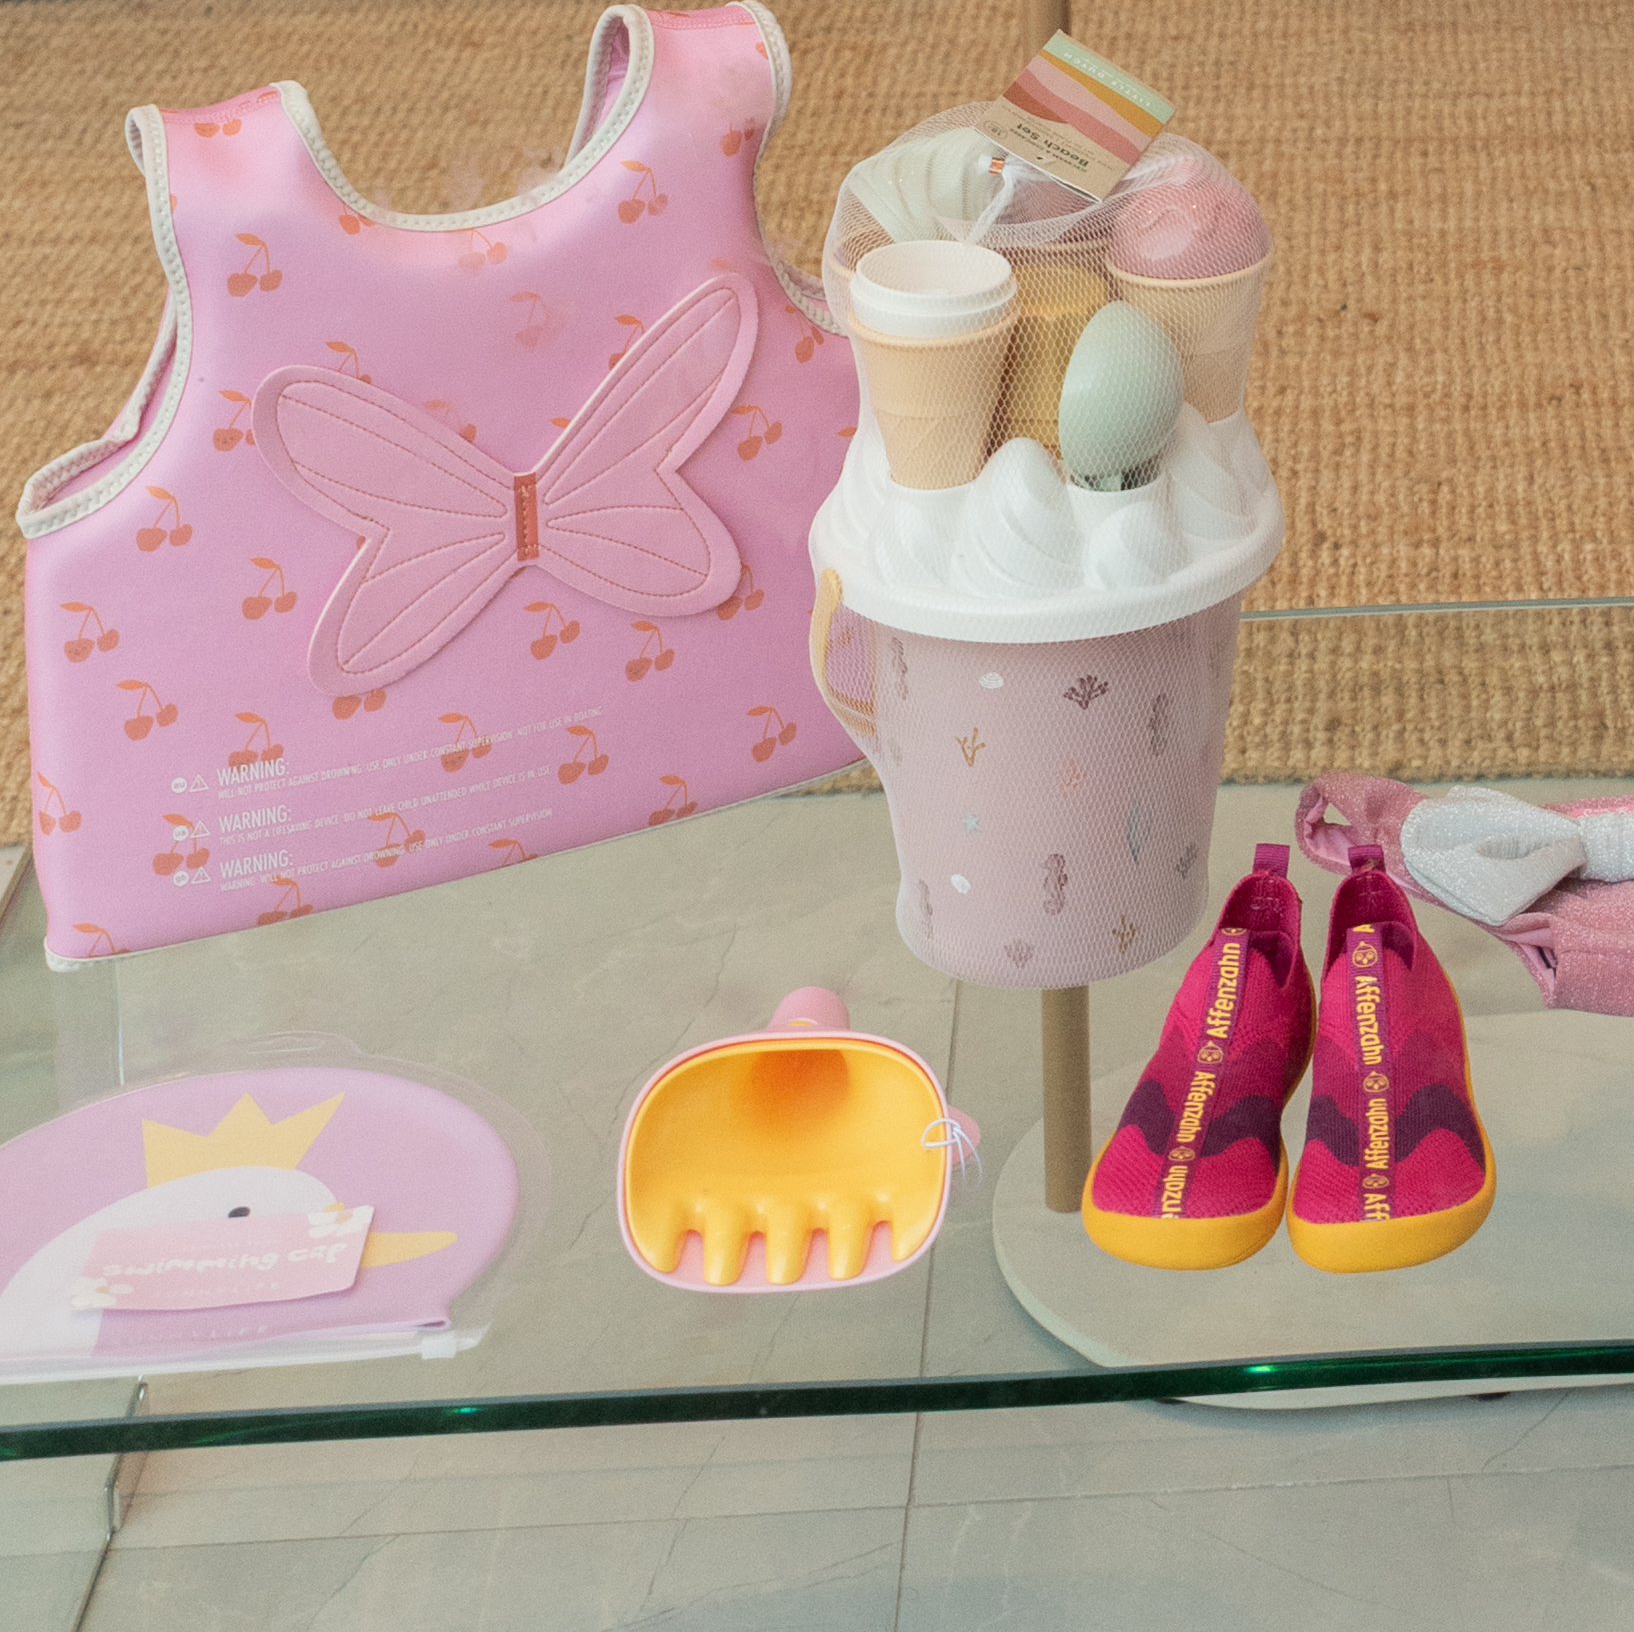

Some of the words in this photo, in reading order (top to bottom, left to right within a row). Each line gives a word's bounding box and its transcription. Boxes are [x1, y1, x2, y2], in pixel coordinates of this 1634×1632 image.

[1063, 52, 1105, 80] DUTCH
[1111, 80, 1152, 108] LITTLE
[1016, 122, 1040, 141] Set
[1043, 138, 1089, 168] Beach
[217, 758, 290, 786] WARNING:
[218, 804, 292, 833] WARNING:
[219, 849, 293, 878] WARNING:
[1205, 943, 1241, 1039] Affenzahn
[1354, 975, 1383, 1066] Affenzahn
[1177, 1070, 1216, 1143] Affenzahn
[1364, 1097, 1390, 1170] Affenzahn
